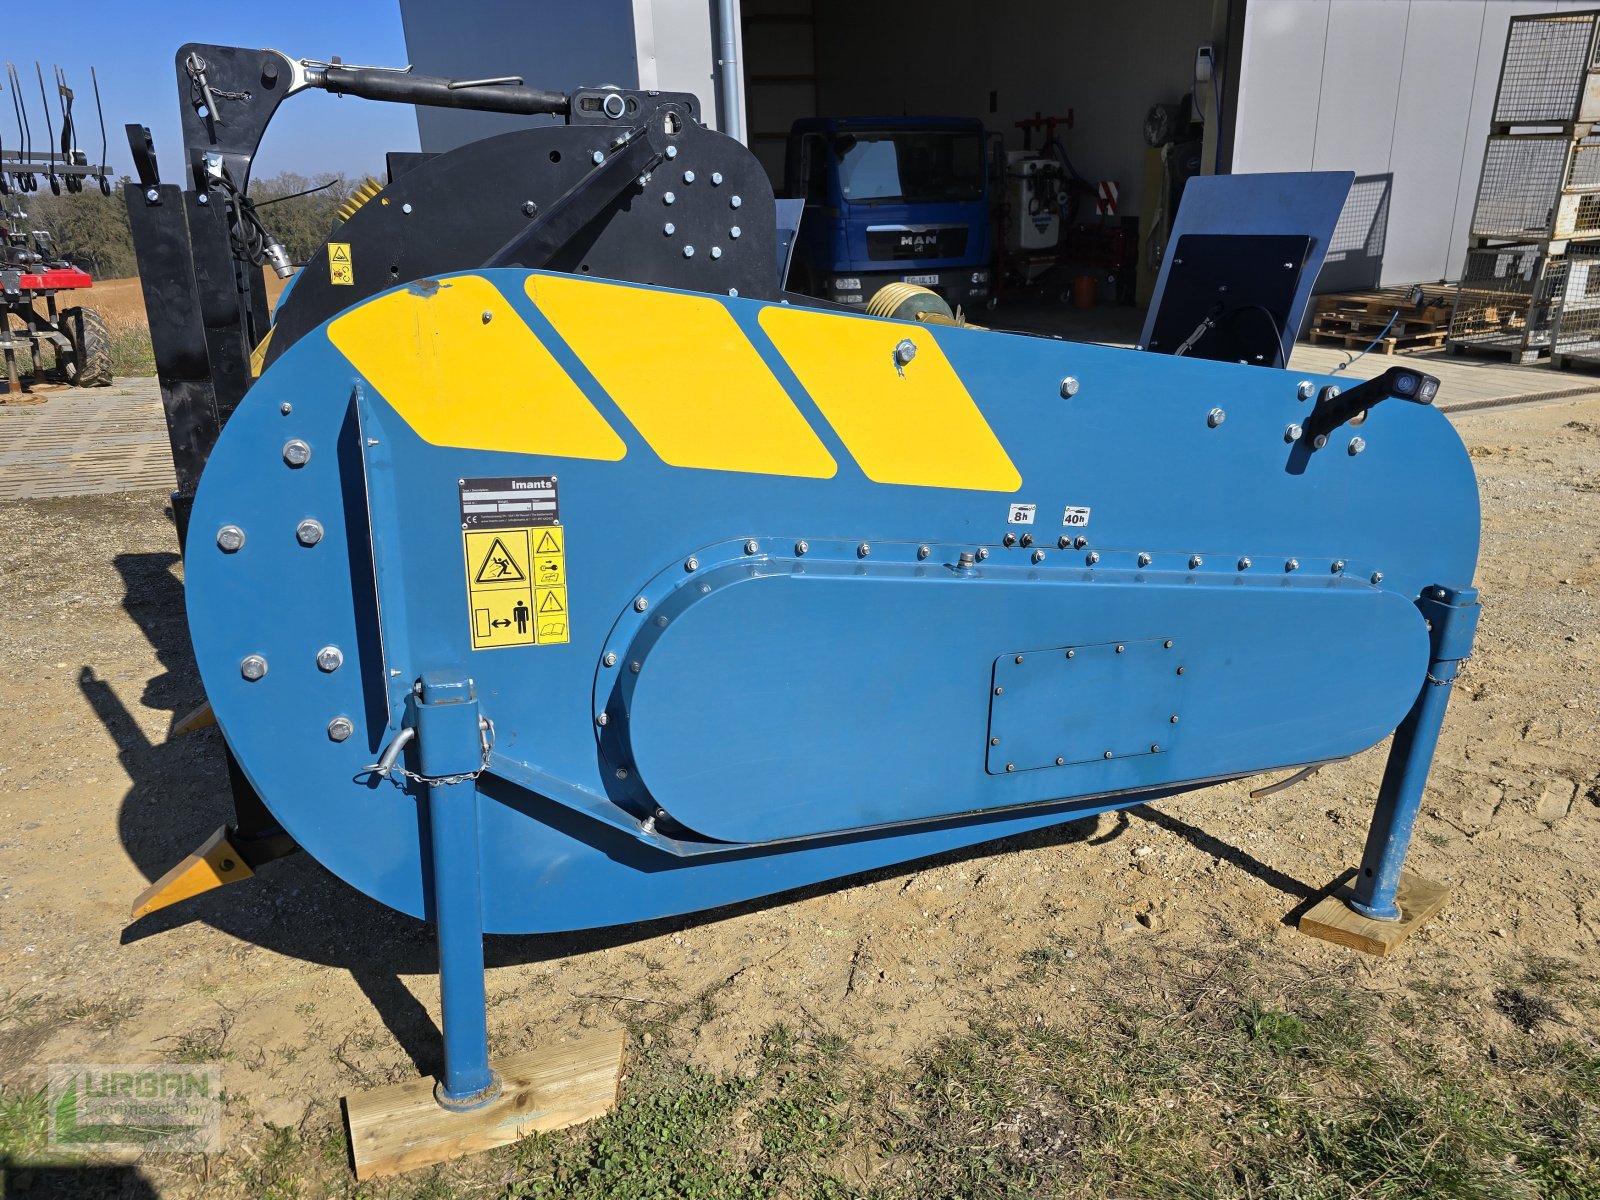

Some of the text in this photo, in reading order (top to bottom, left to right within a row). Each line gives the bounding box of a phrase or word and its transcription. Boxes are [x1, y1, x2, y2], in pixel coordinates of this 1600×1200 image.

[901, 236, 937, 245] MAN
[1014, 512, 1028, 521] 8h
[1065, 515, 1085, 524] 40h
